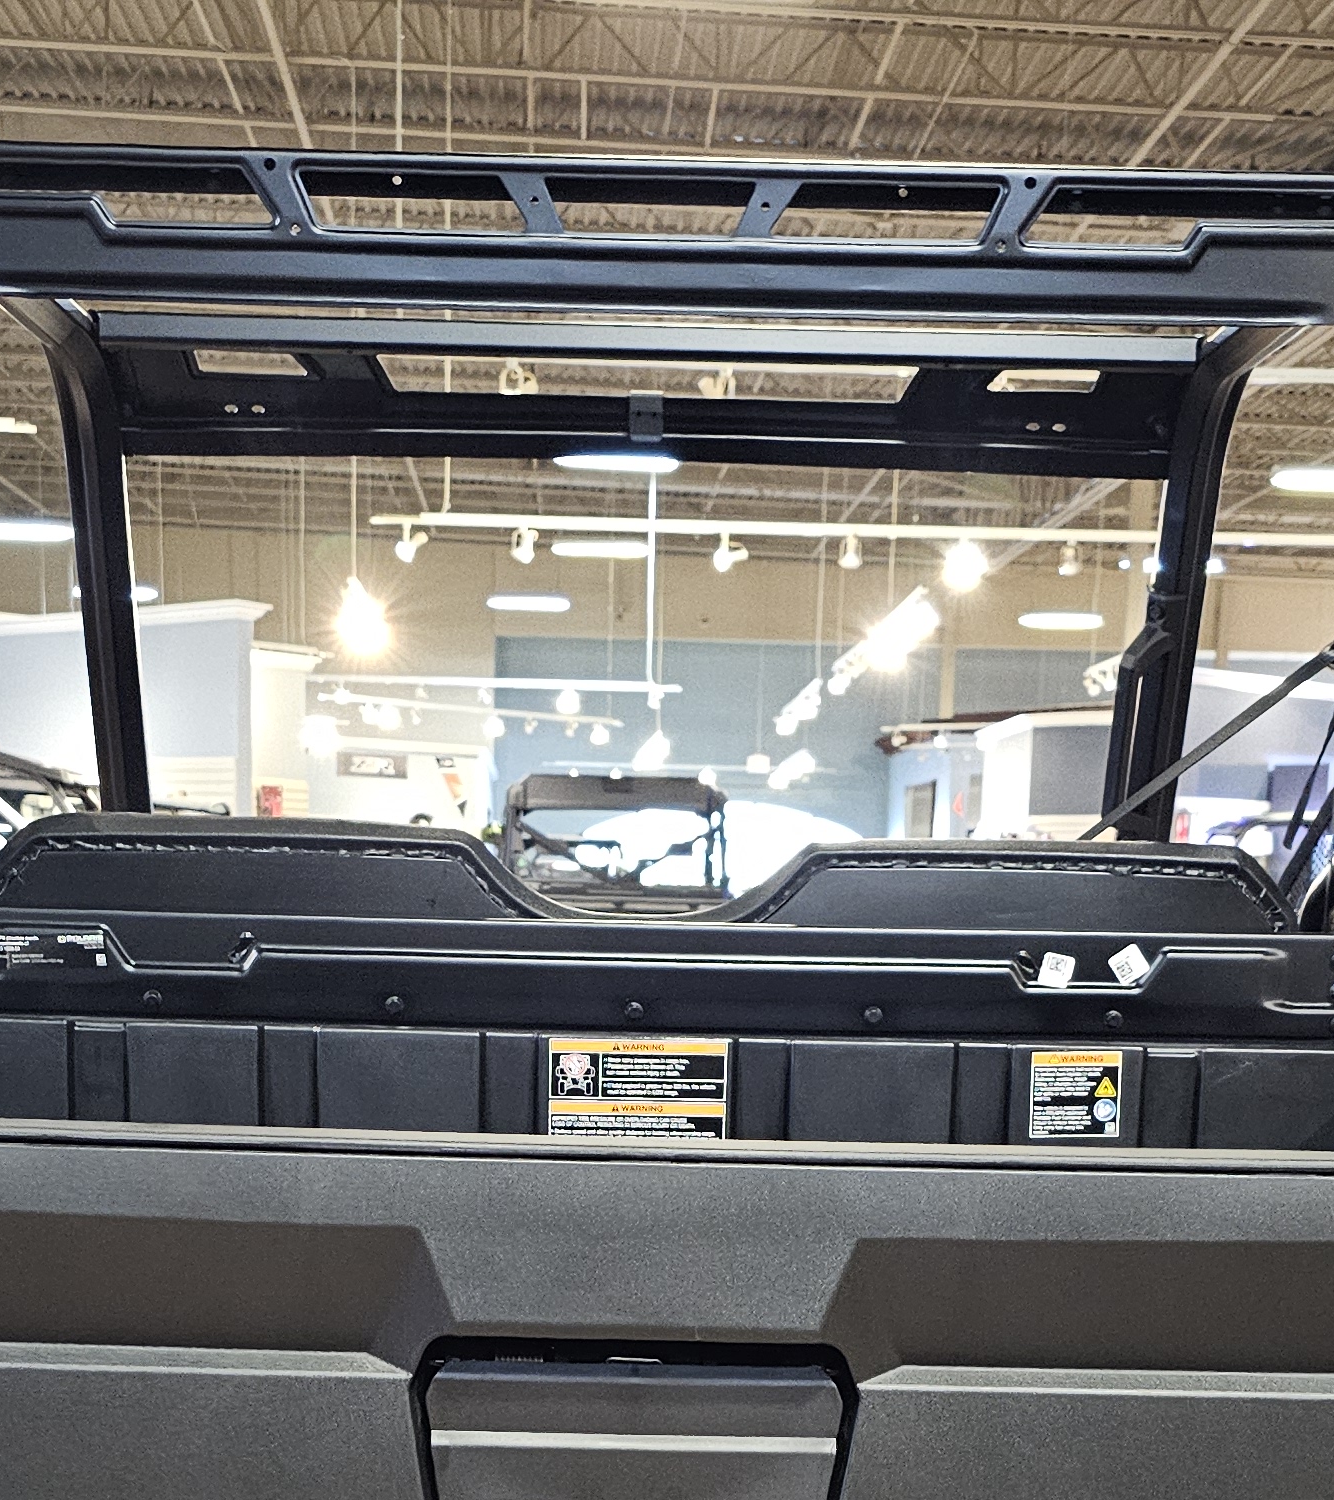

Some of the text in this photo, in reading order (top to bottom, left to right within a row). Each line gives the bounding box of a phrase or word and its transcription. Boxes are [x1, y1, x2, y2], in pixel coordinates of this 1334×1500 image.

[622, 1043, 665, 1052] WARNING
[1060, 1054, 1104, 1063] WARNING
[621, 1104, 664, 1113] WARNING
